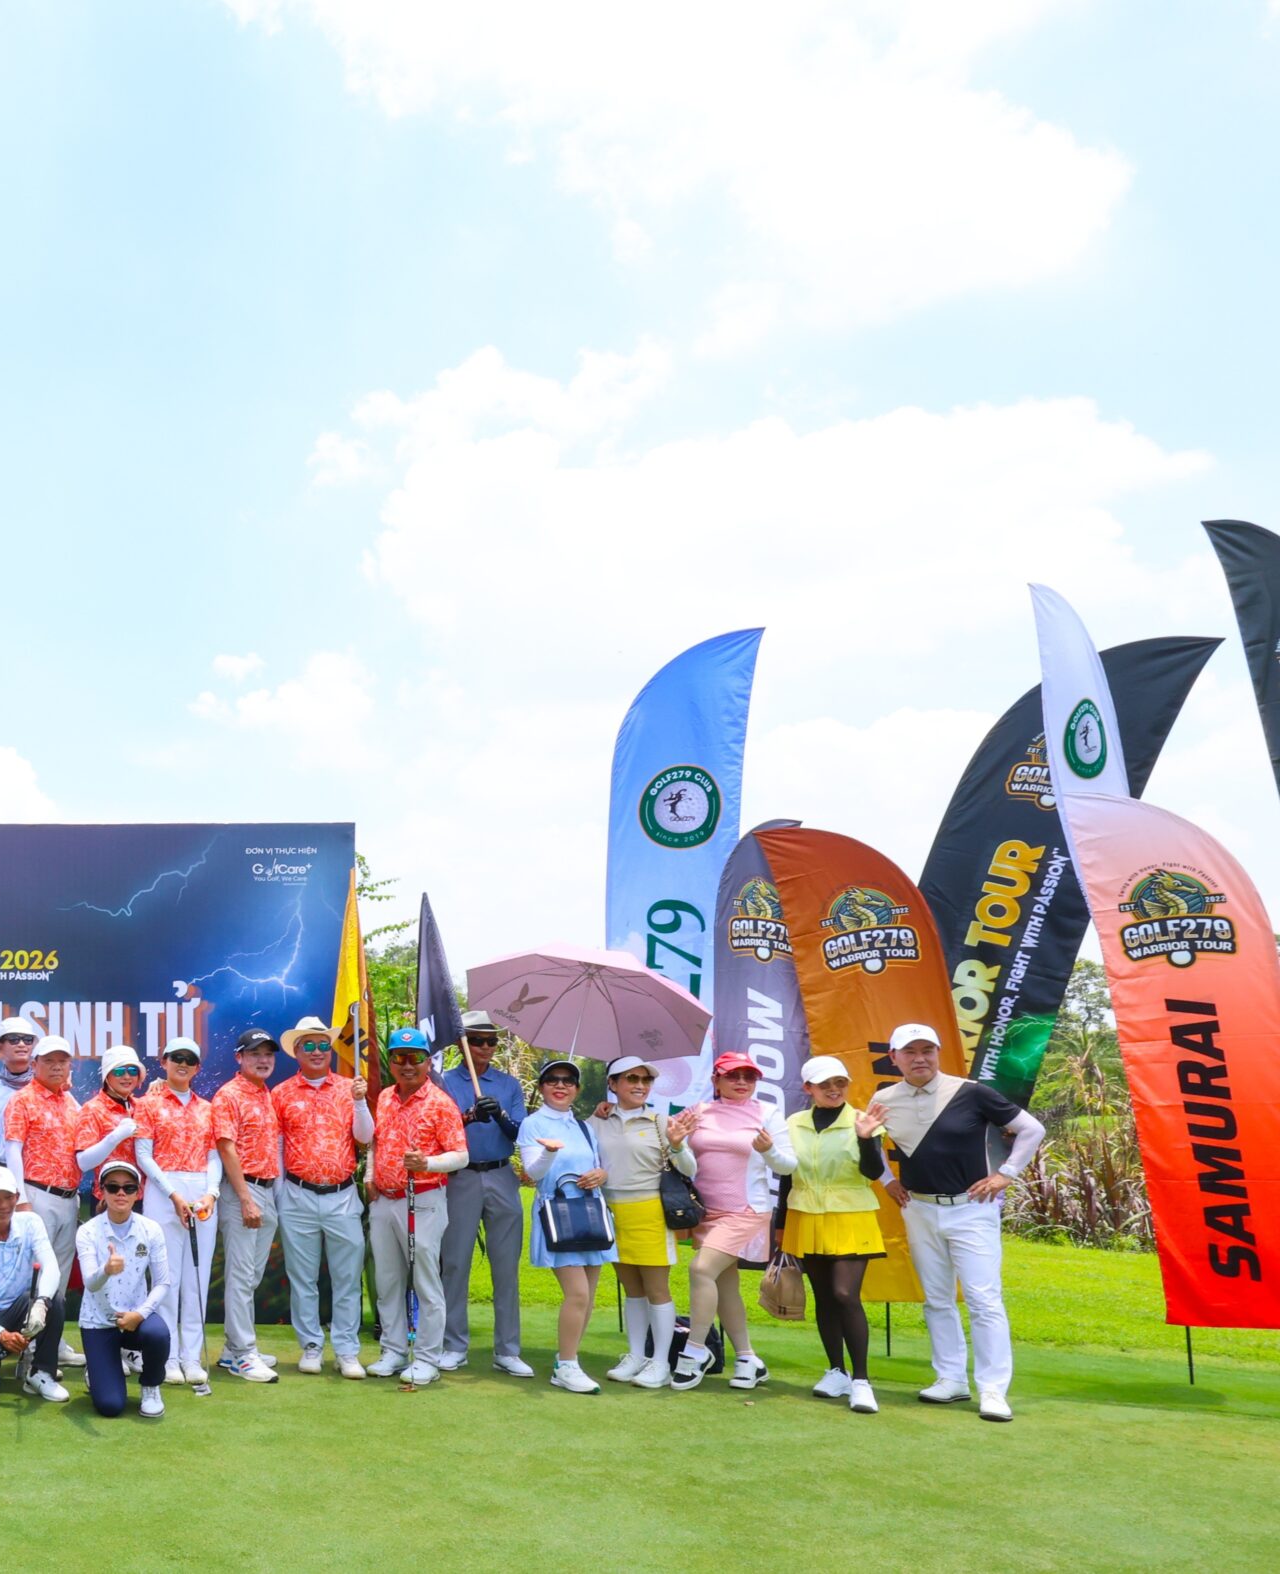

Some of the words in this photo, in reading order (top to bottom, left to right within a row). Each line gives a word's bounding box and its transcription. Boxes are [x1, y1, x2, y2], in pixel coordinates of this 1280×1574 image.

[650, 770, 692, 796] GOLF279
[694, 773, 713, 792] CLUB
[1011, 783, 1053, 793] WARRIO
[964, 839, 1046, 947] TOUR
[1033, 847, 1072, 914] PASSION"
[1205, 895, 1226, 903] 2022
[732, 938, 770, 948] WARRIOR
[773, 941, 793, 952] TOU
[825, 929, 915, 959] GOLF279
[1020, 914, 1045, 948] WITH
[1124, 919, 1232, 948] GOLF279
[0, 950, 59, 970] 2026
[829, 949, 881, 968] WARRIOR
[884, 948, 916, 957] TOUR
[1128, 941, 1190, 959] WARRIOR
[1195, 940, 1232, 951] TOUR
[1006, 951, 1031, 993] FIGHT
[19, 1001, 124, 1057] SINH
[139, 981, 202, 1057] TỬ
[989, 994, 1020, 1046] HONOR,
[978, 1042, 1001, 1081] WITH
[1164, 998, 1262, 1283] SAMURAI
